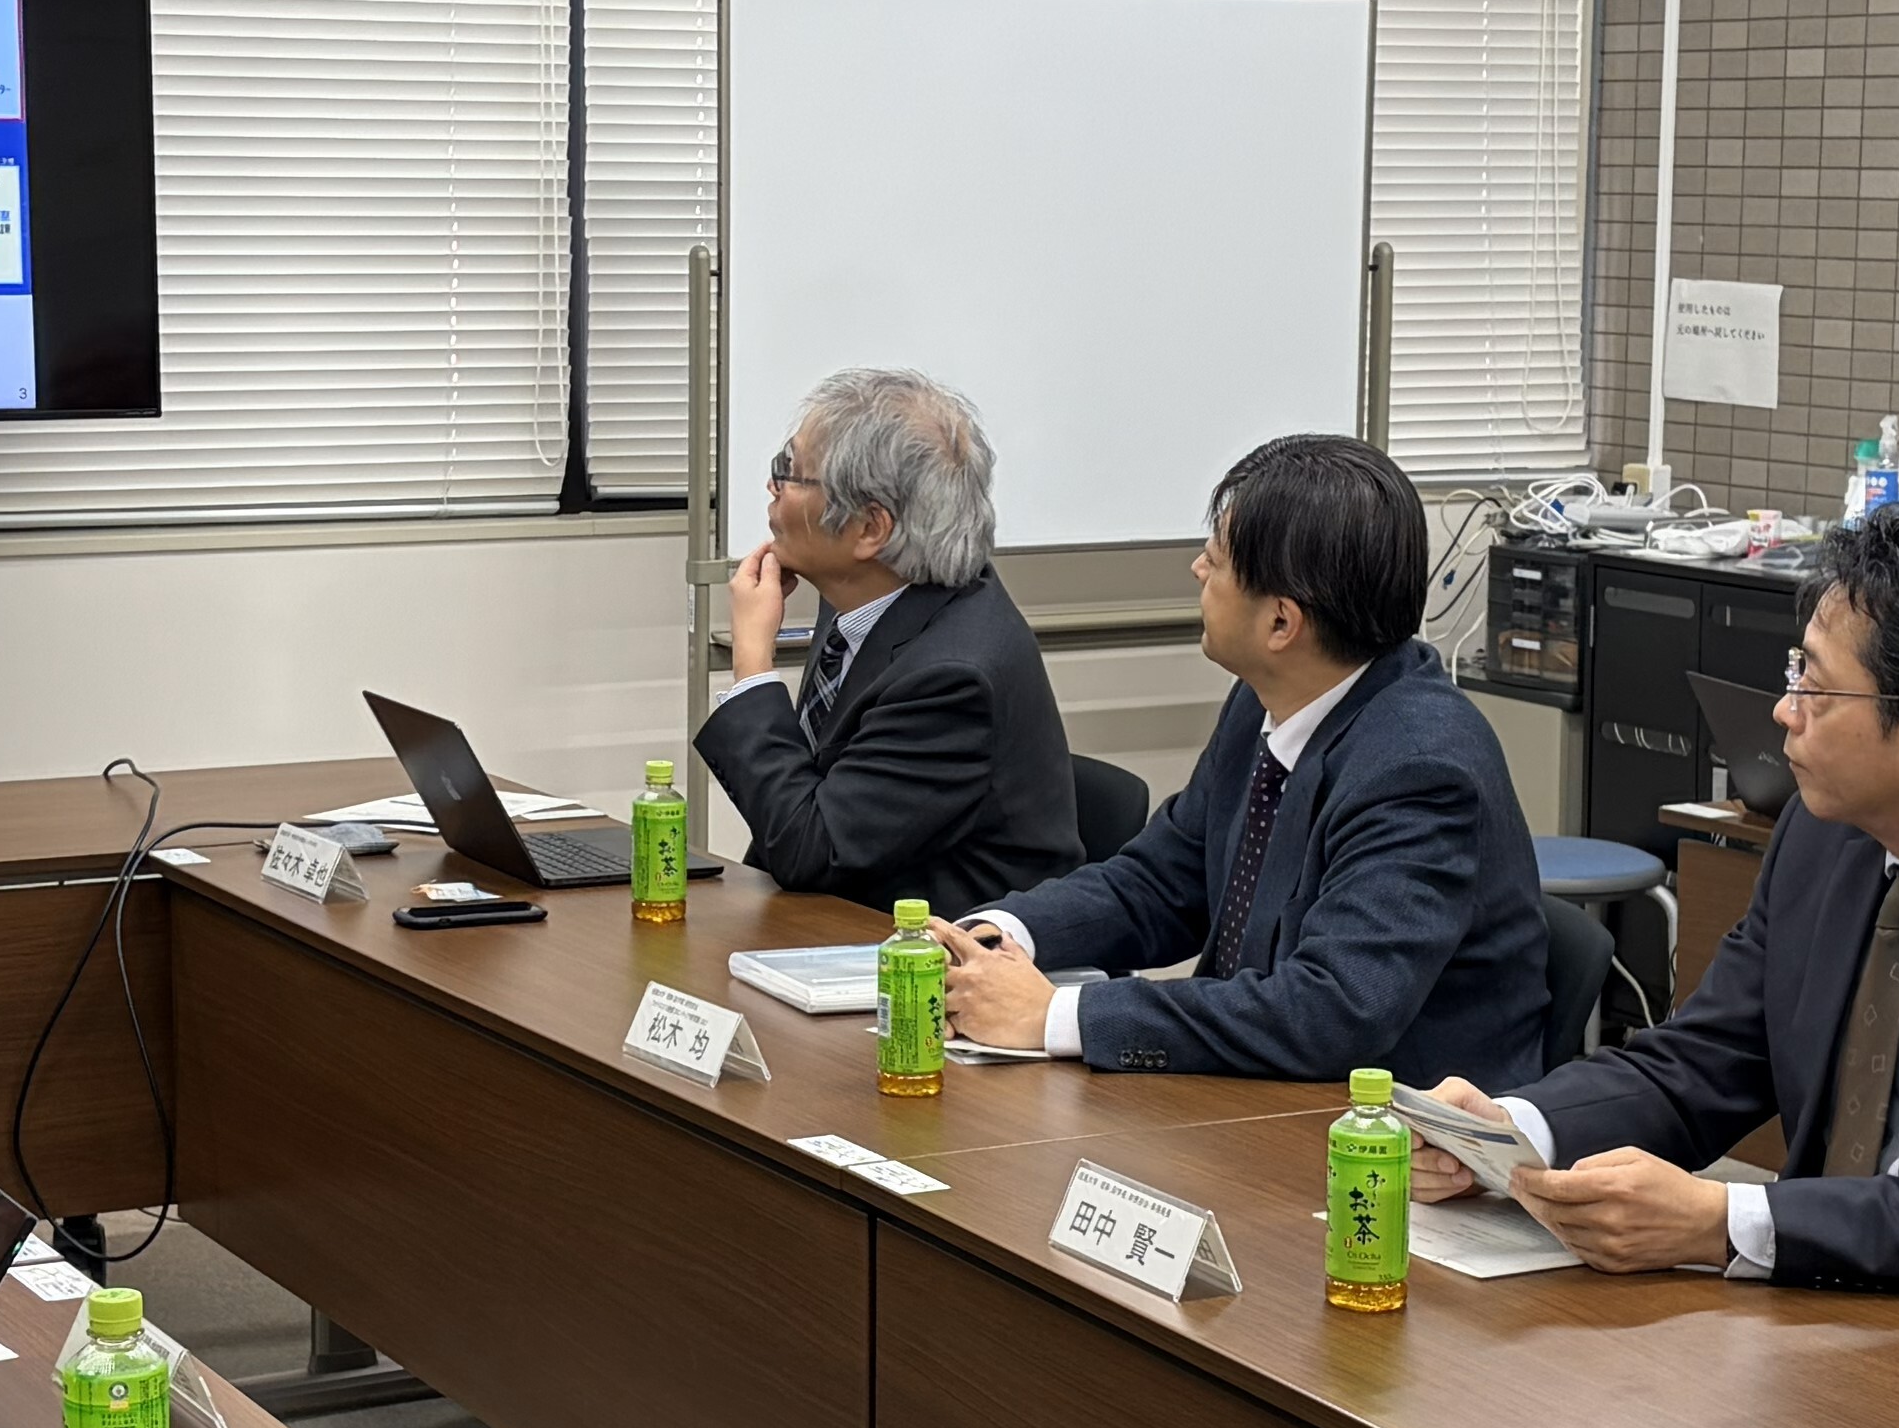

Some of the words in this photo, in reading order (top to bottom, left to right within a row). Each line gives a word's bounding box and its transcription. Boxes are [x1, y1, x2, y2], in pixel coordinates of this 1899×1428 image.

[19, 388, 27, 399] 3
[647, 1012, 683, 1049] 松木
[689, 1028, 710, 1060] 均
[1069, 1201, 1116, 1246] 田中
[1126, 1223, 1175, 1266] 賢一
